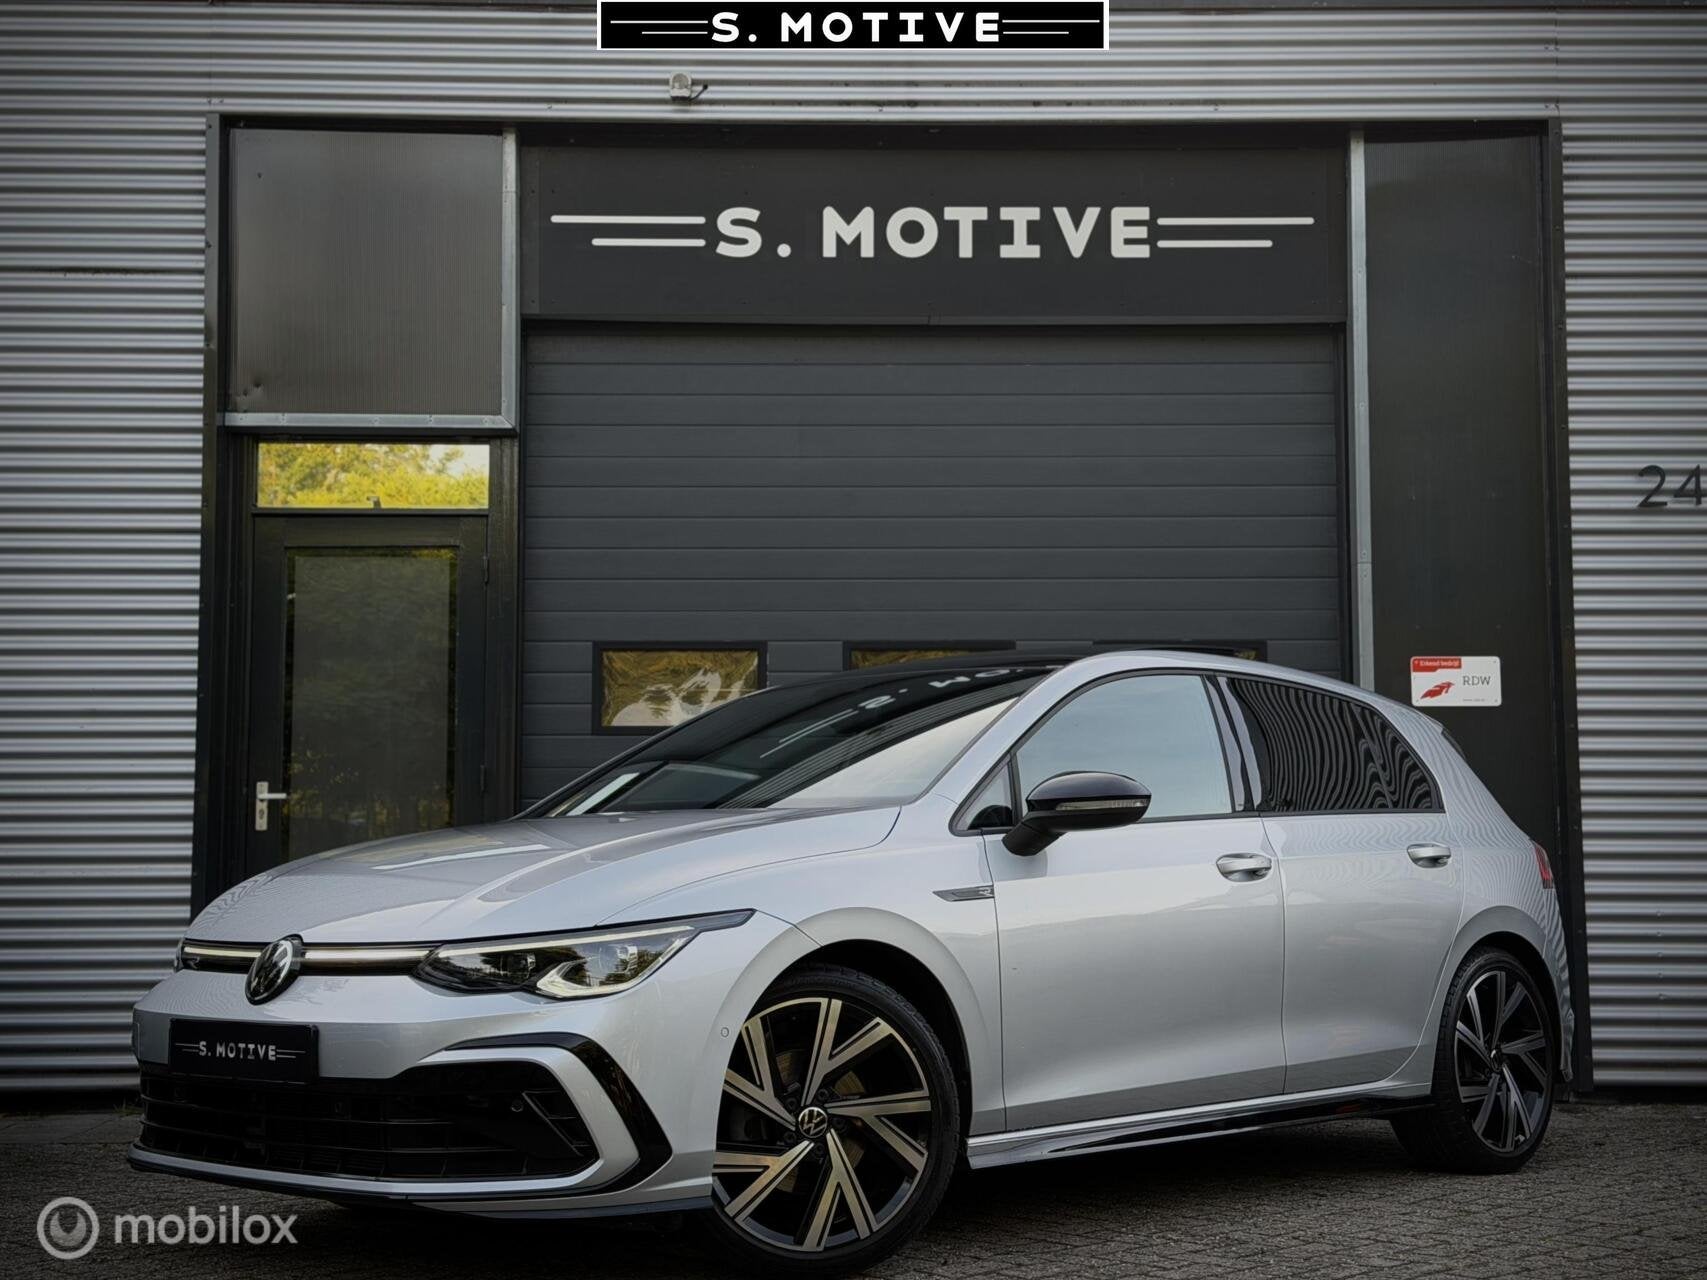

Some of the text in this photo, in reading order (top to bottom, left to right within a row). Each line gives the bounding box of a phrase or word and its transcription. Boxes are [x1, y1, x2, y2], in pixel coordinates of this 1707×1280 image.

[715, 206, 1151, 259] S. MOTIVE
[1637, 464, 1704, 507] 24
[1462, 675, 1491, 686] RDW
[199, 1041, 277, 1061] S. MOTIVE
